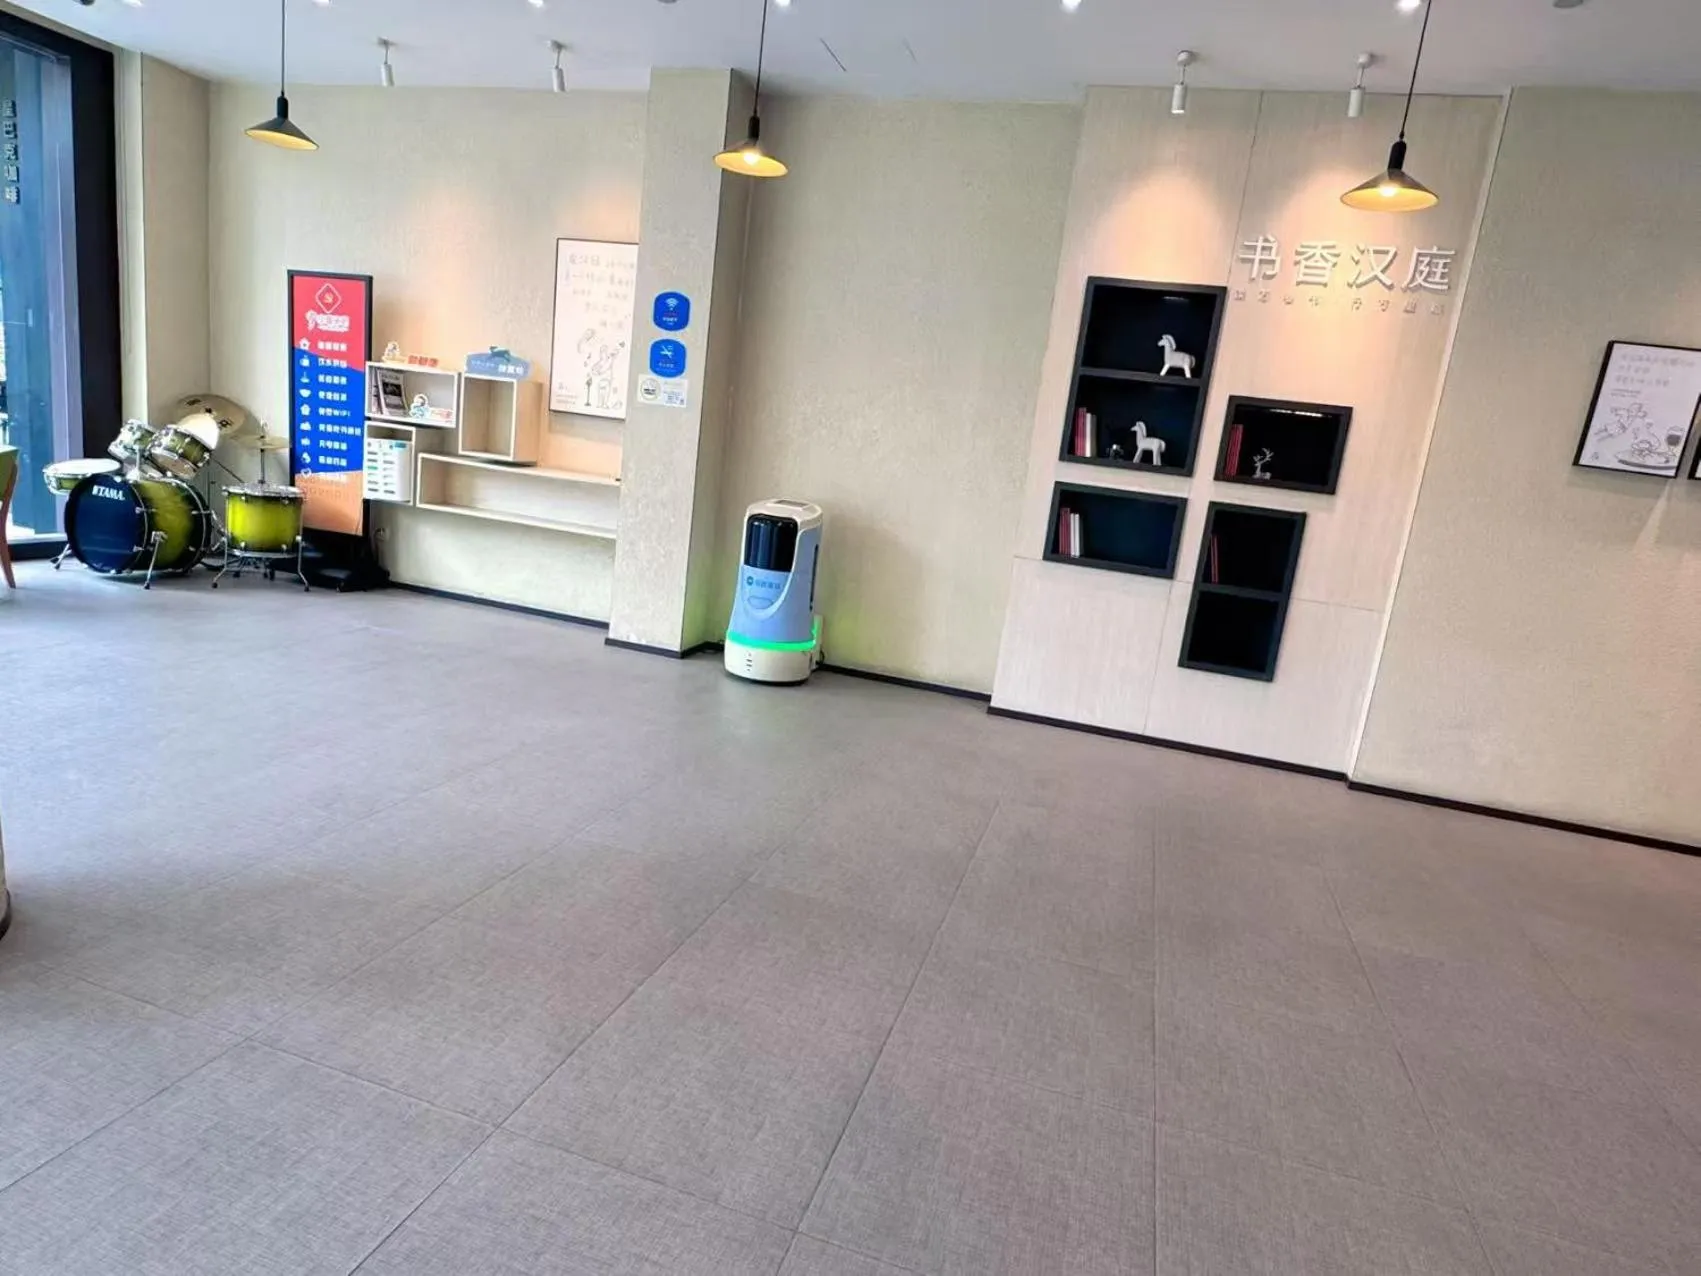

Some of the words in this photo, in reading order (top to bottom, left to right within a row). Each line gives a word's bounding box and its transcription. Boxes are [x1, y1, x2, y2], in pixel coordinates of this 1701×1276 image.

[1239, 234, 1456, 292] 书香汉庭
[97, 485, 126, 501] TAMA
